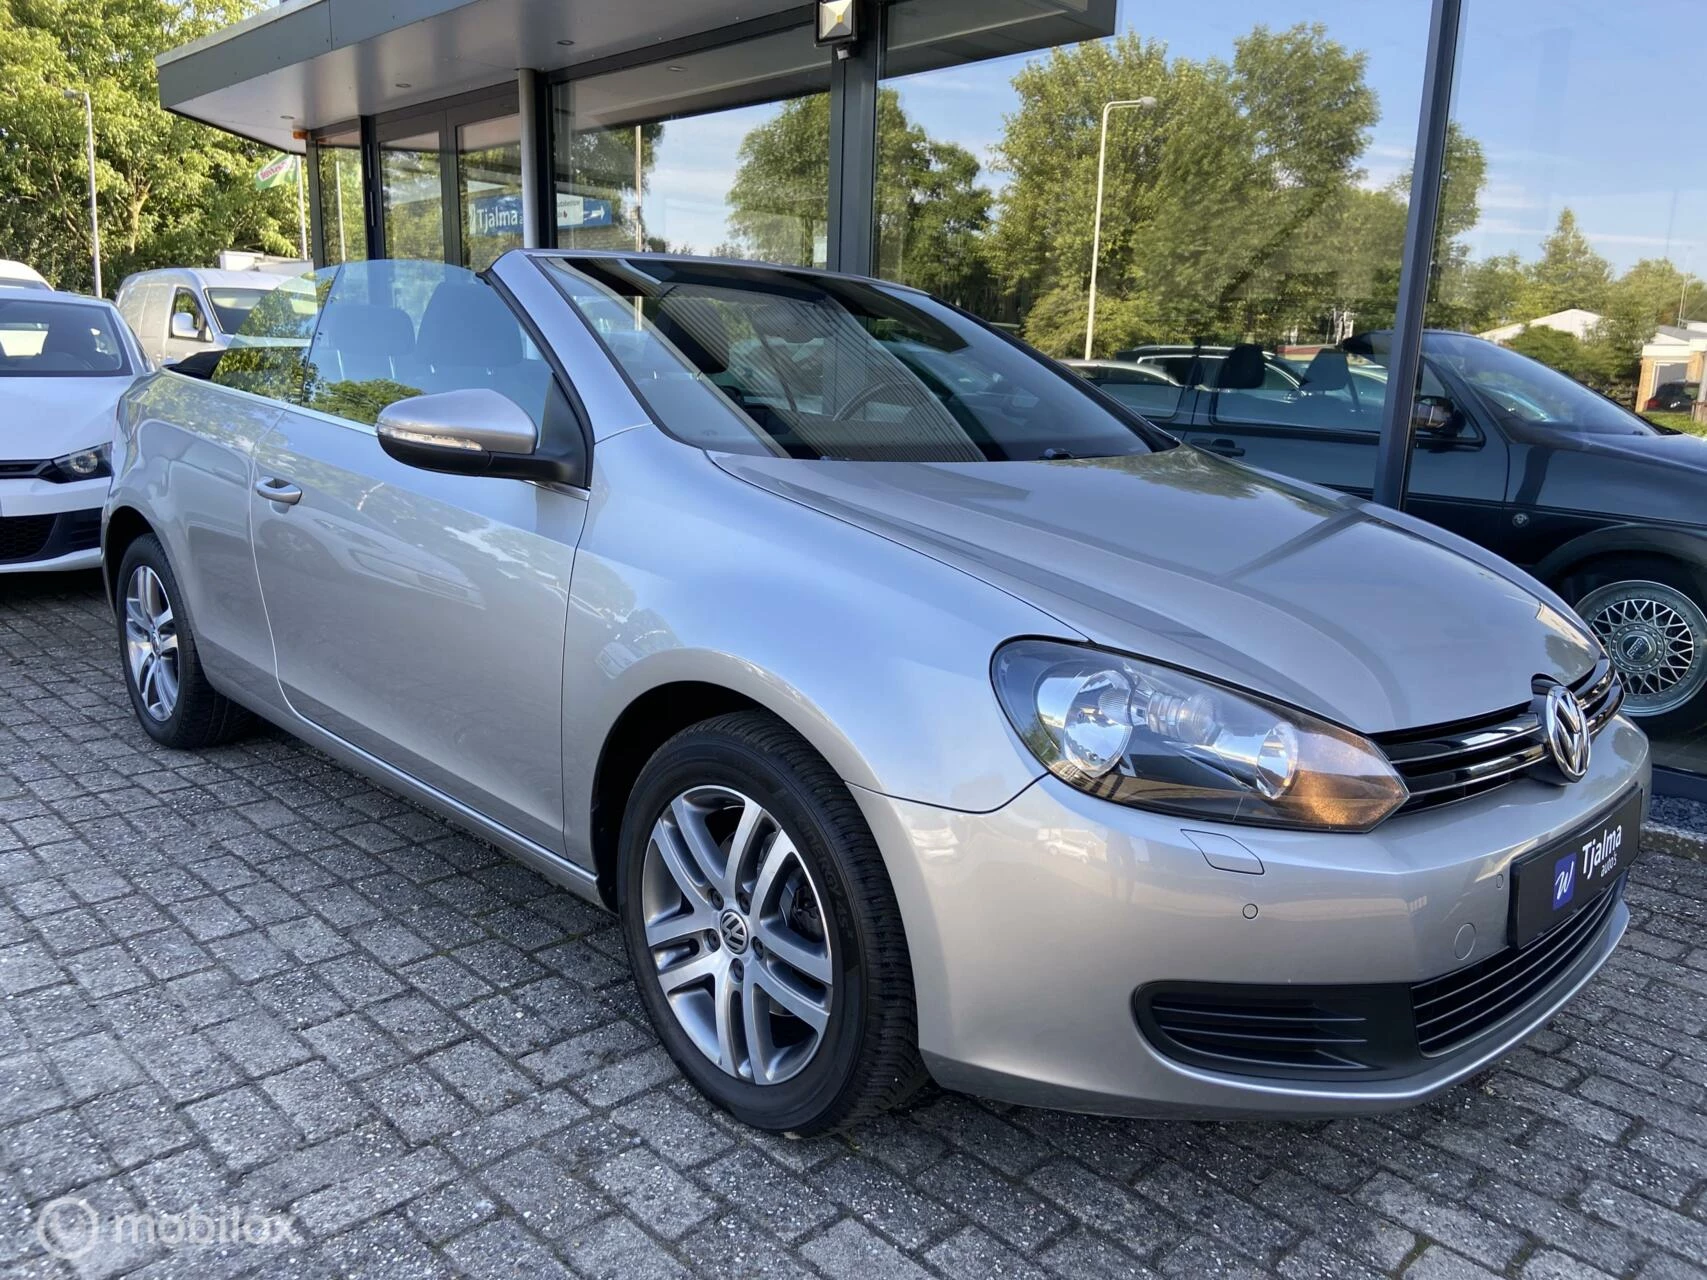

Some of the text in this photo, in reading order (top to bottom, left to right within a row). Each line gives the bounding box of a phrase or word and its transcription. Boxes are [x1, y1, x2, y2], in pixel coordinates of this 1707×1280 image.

[477, 205, 518, 233] Tjalma
[1582, 825, 1622, 880] Tjalma
[1601, 853, 1617, 877] auto's
